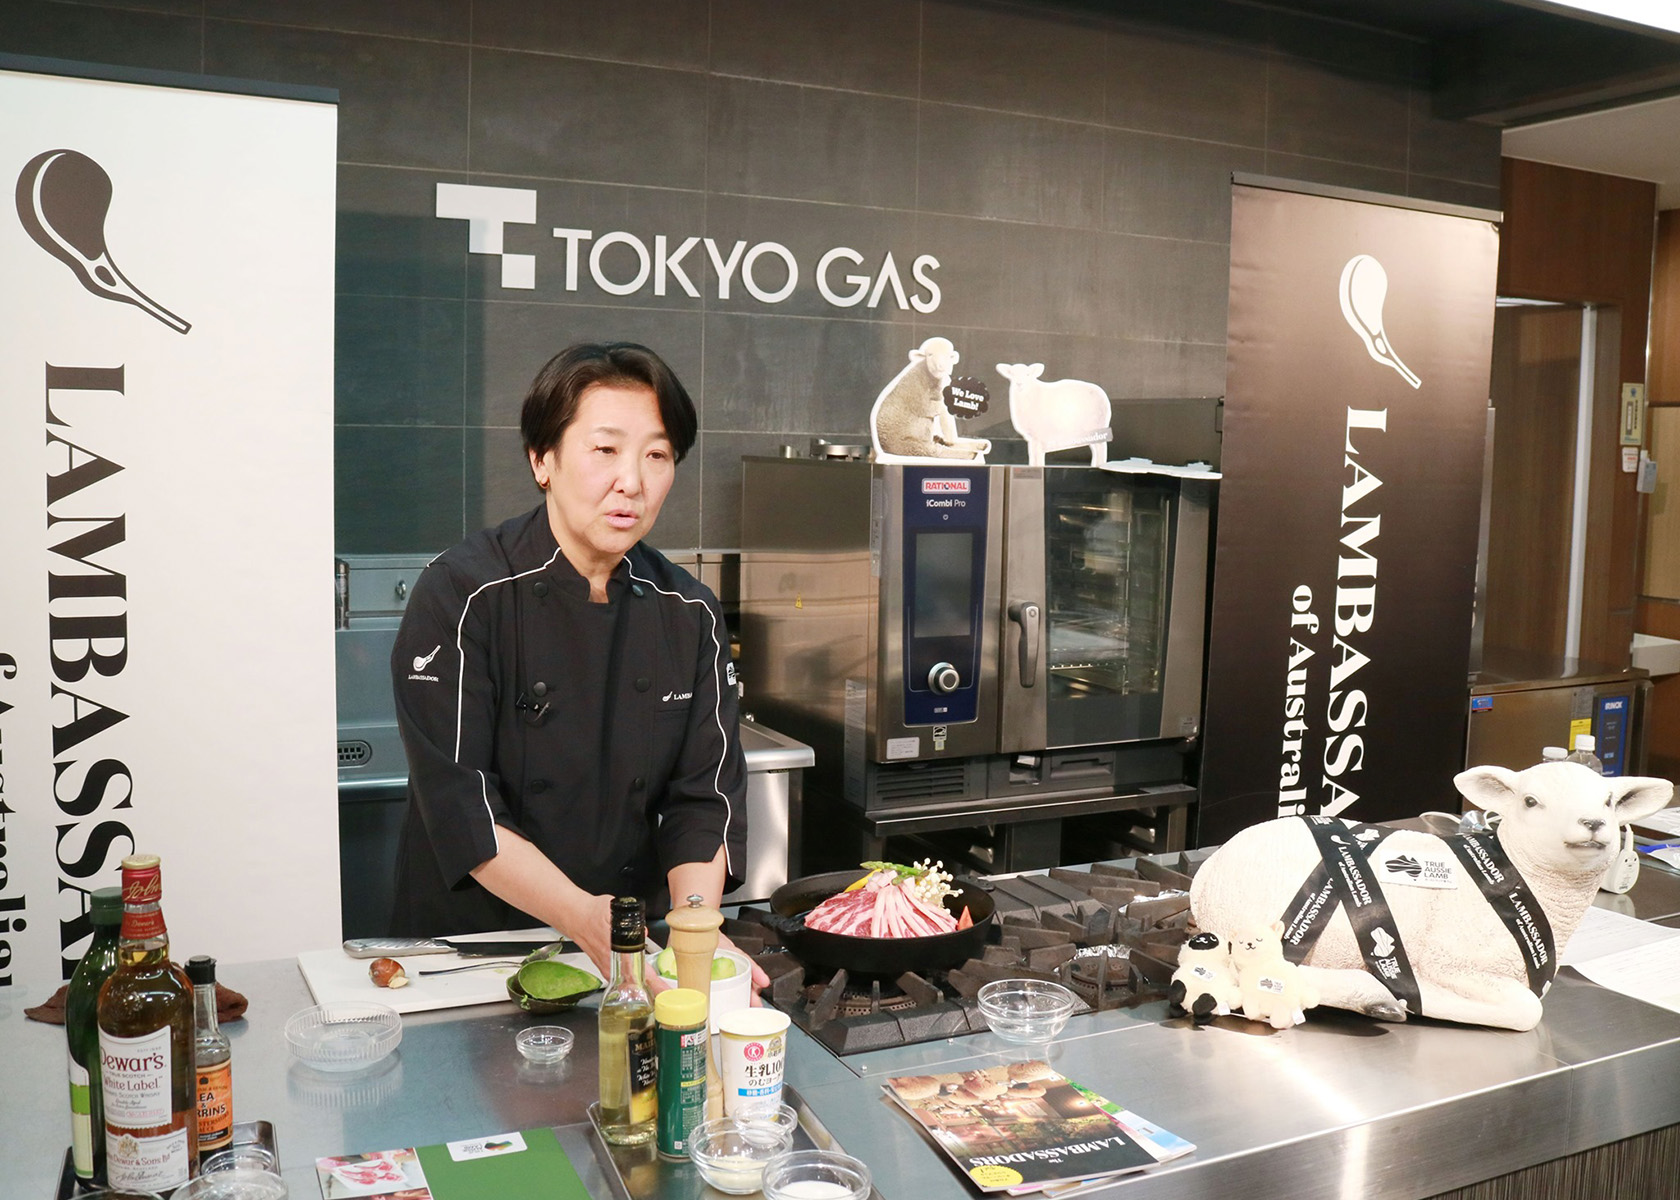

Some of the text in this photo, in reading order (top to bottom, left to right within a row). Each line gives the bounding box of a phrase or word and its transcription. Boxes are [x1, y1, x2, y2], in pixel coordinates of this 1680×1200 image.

[553, 228, 942, 314] TOKYO GAS
[951, 386, 984, 402] We Love
[954, 397, 979, 411] Lamb!
[925, 482, 968, 490] RATIONAL
[926, 499, 966, 508] iCombi Pro
[1292, 584, 1320, 635] of
[46, 361, 136, 980] LAMBASSA
[1338, 846, 1373, 906] LAMBASSADOR
[1508, 892, 1549, 965] LAMBASSADOR
[127, 1078, 159, 1091] Label
[198, 1092, 214, 1102] EA
[969, 1136, 1126, 1167] LAMBASSADORS
